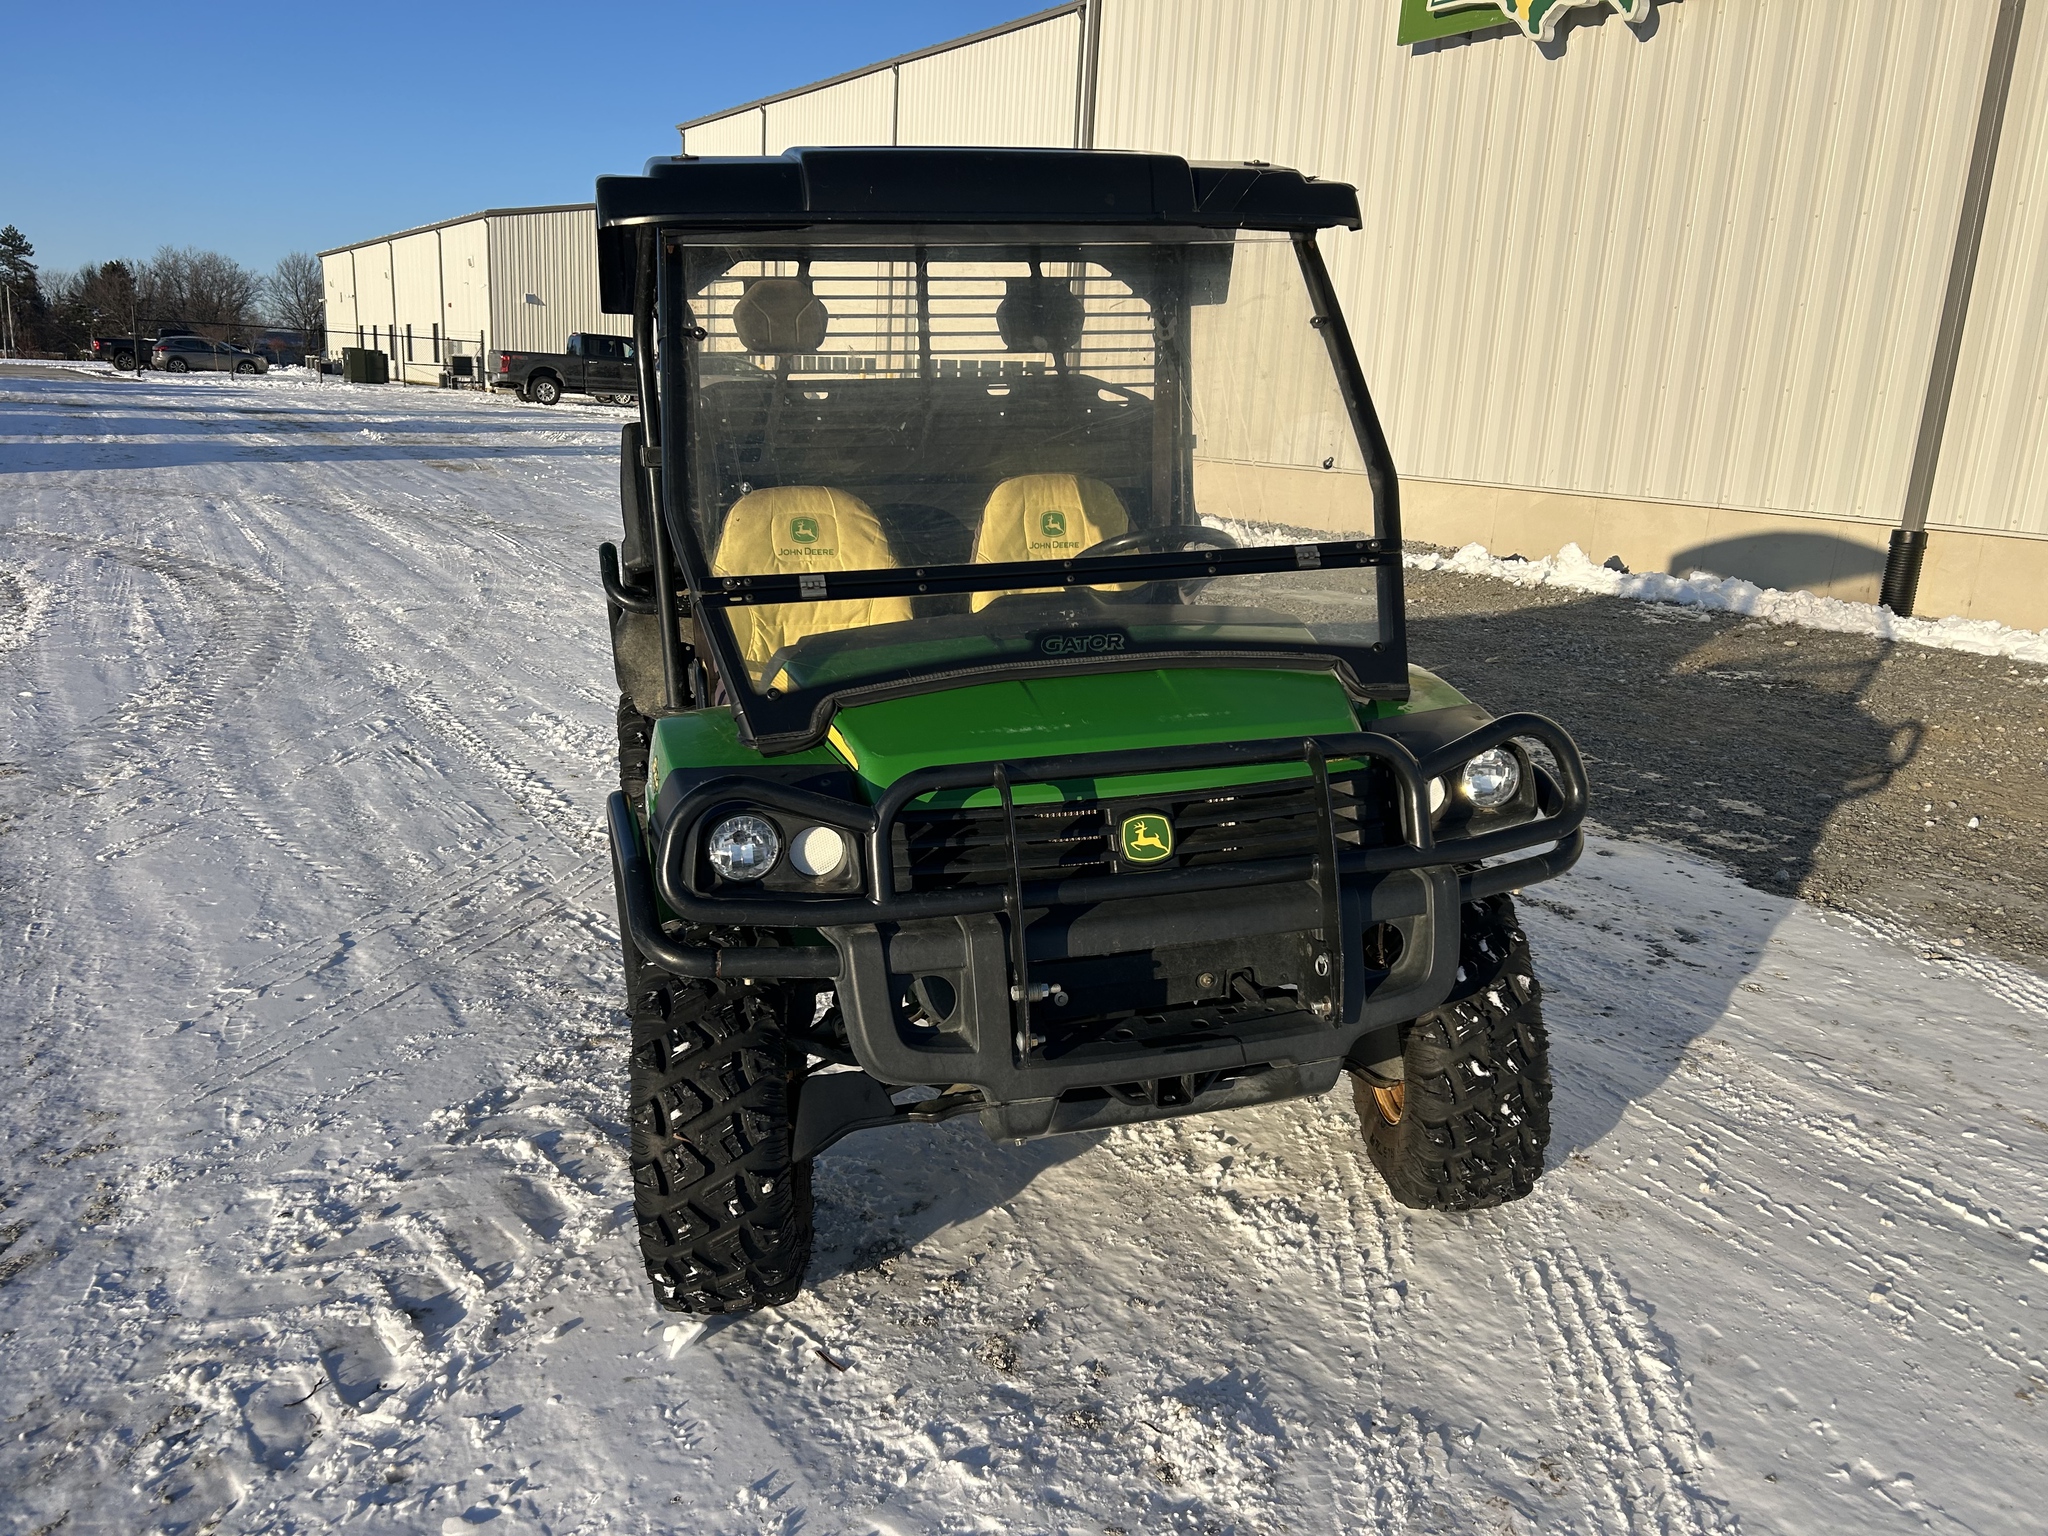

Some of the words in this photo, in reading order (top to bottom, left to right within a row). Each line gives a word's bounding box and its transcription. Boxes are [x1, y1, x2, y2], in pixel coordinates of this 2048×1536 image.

[1029, 541, 1051, 550] JOHN
[1052, 540, 1080, 549] DEERE
[778, 547, 803, 557] JOHN
[804, 547, 835, 556] DEERE
[1041, 633, 1125, 655] GATOR
